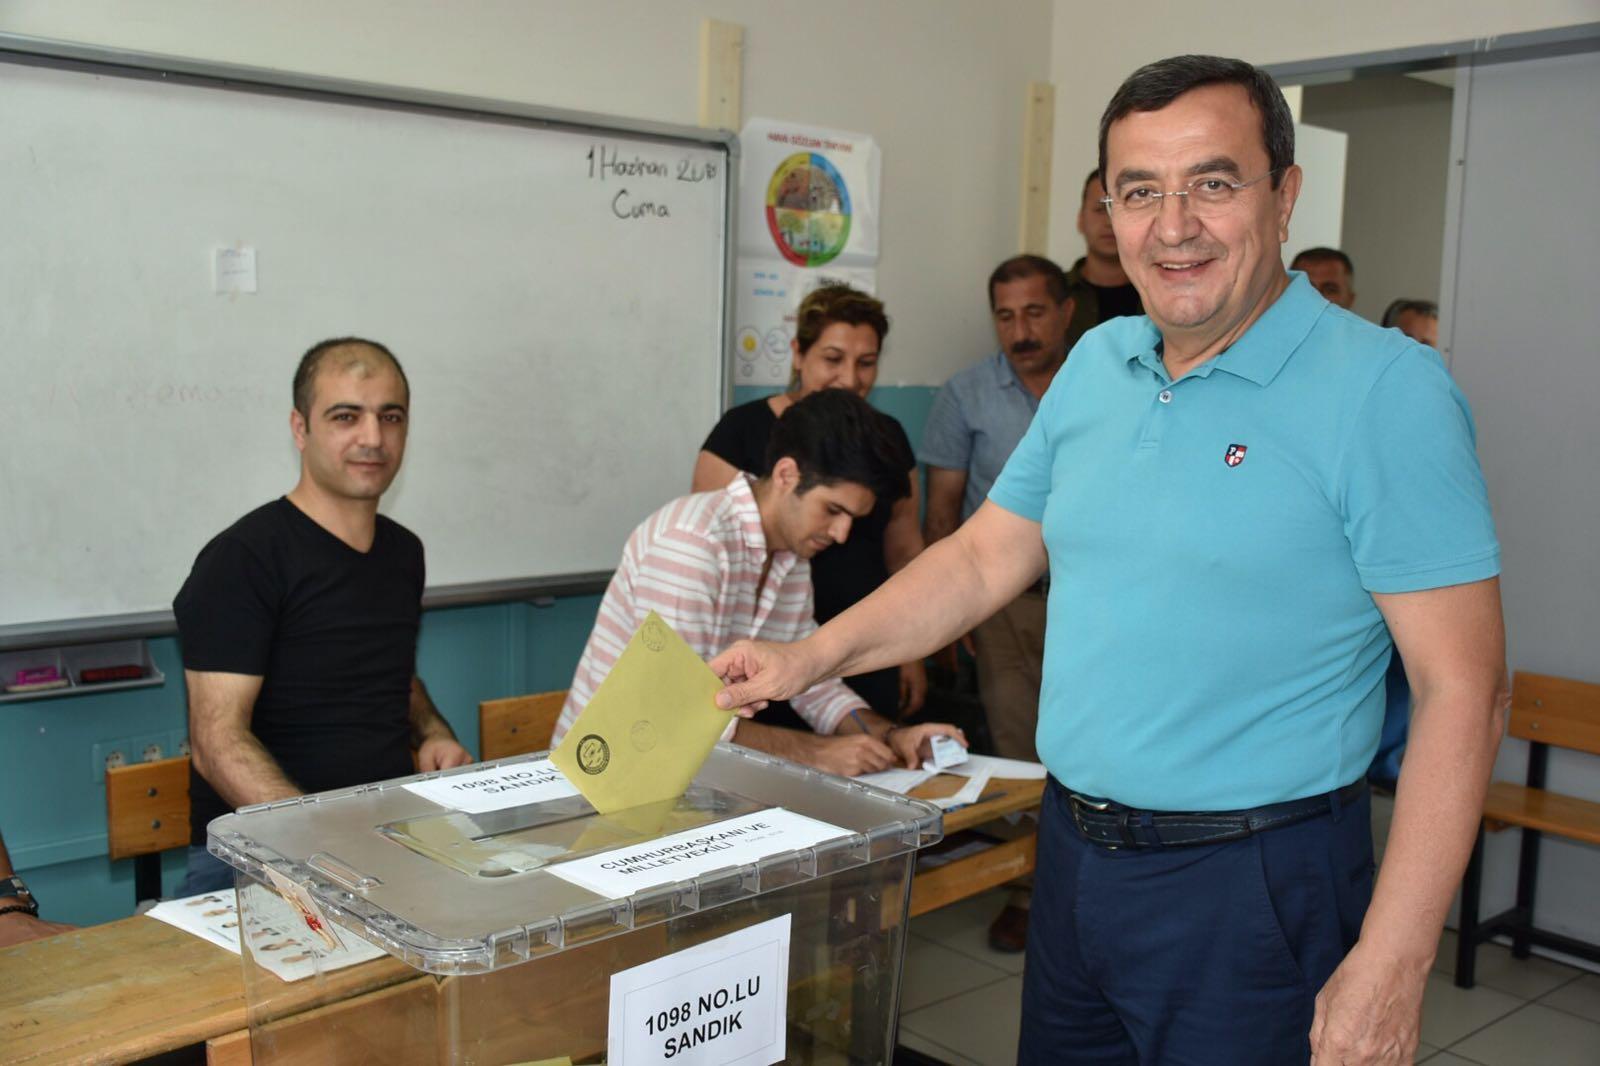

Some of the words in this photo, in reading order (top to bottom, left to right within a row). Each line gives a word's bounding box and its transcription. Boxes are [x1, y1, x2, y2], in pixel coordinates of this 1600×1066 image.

[611, 187, 671, 219] Cuma
[451, 778, 500, 792] 1098
[483, 775, 567, 794] SANDIK
[744, 822, 773, 832] VE
[645, 1001, 692, 1036] 1098
[698, 975, 761, 1016] NO.LU
[664, 1010, 743, 1059] SANDIK
